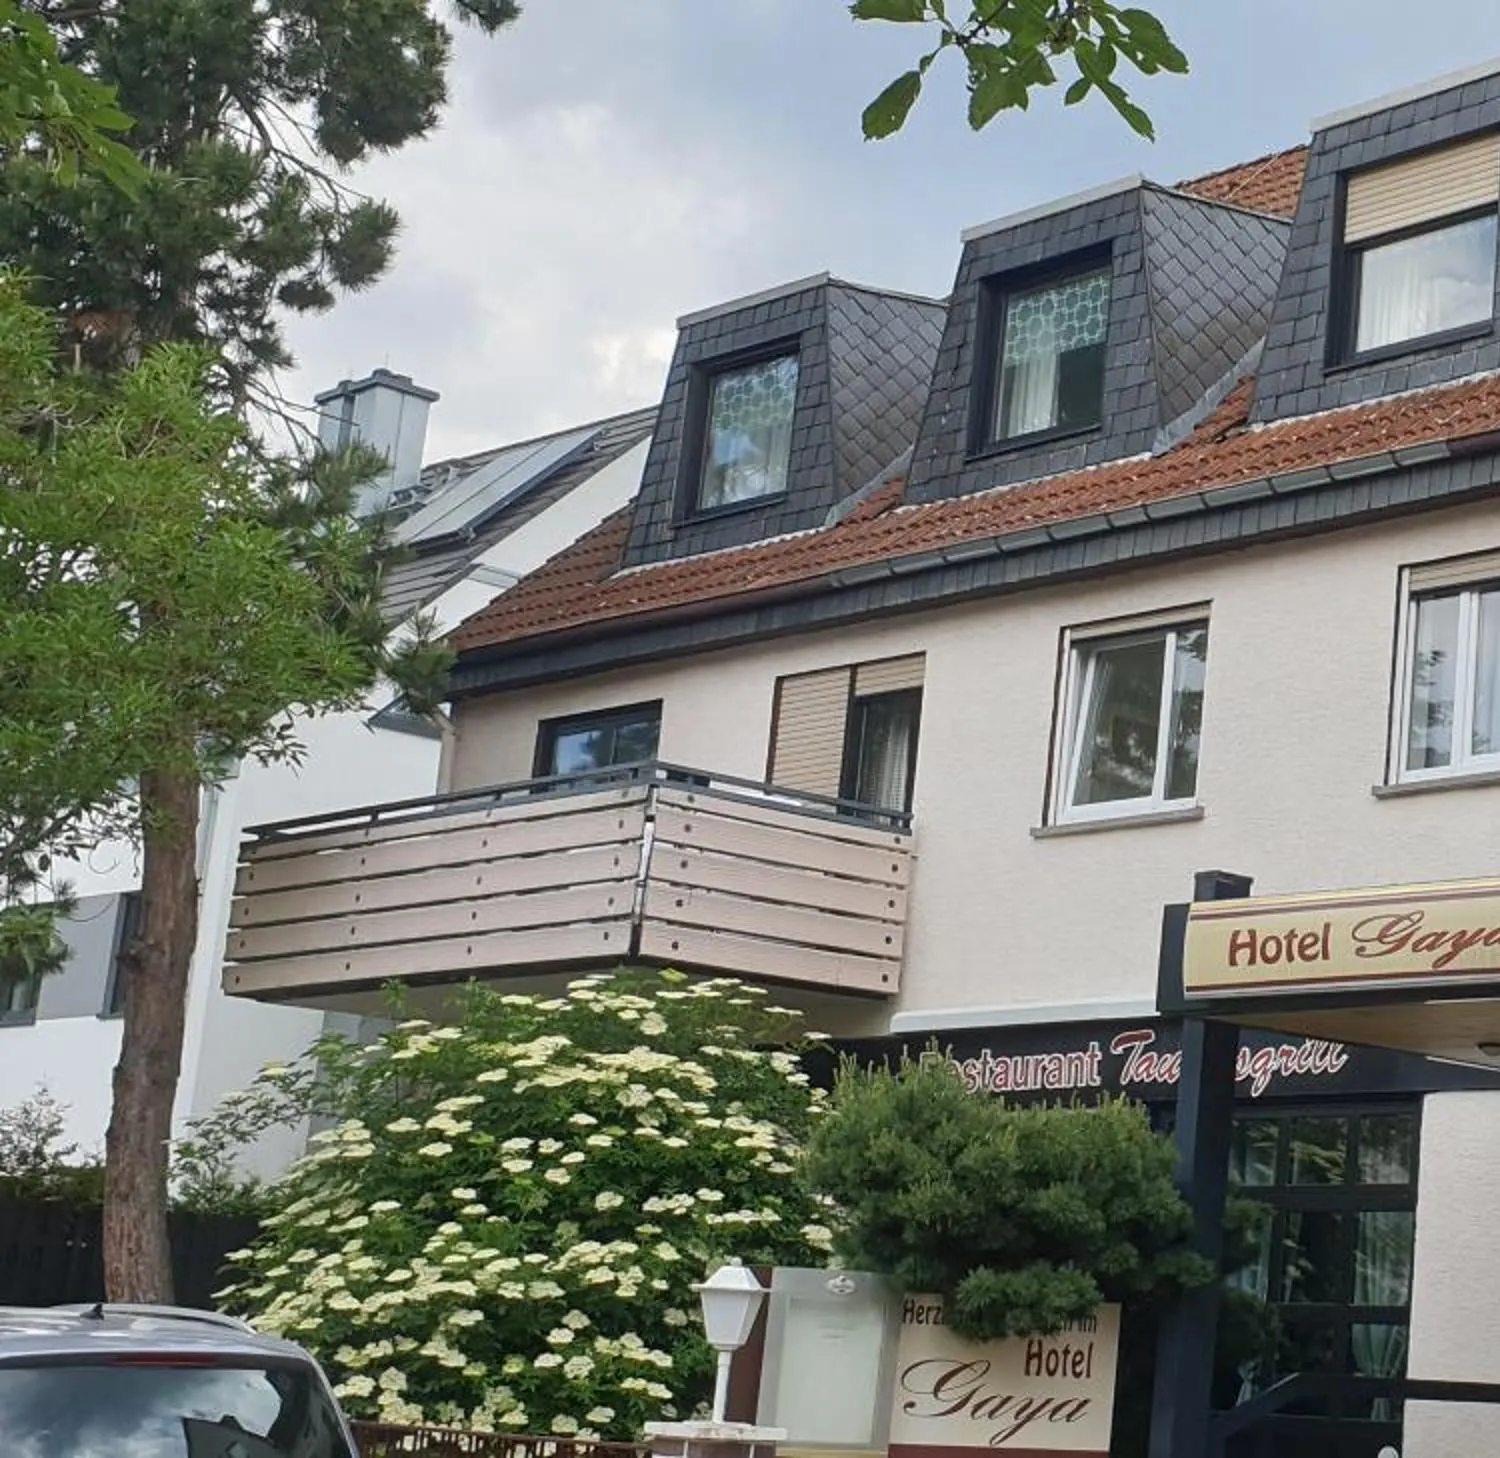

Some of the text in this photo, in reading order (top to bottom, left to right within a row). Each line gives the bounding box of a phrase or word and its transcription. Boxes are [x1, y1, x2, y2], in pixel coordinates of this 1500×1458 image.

[1228, 921, 1332, 967] Hotel
[1110, 1029, 1349, 1097] Tausgrill
[1023, 1338, 1095, 1380] Hotel
[900, 1357, 1094, 1446] Gaya
